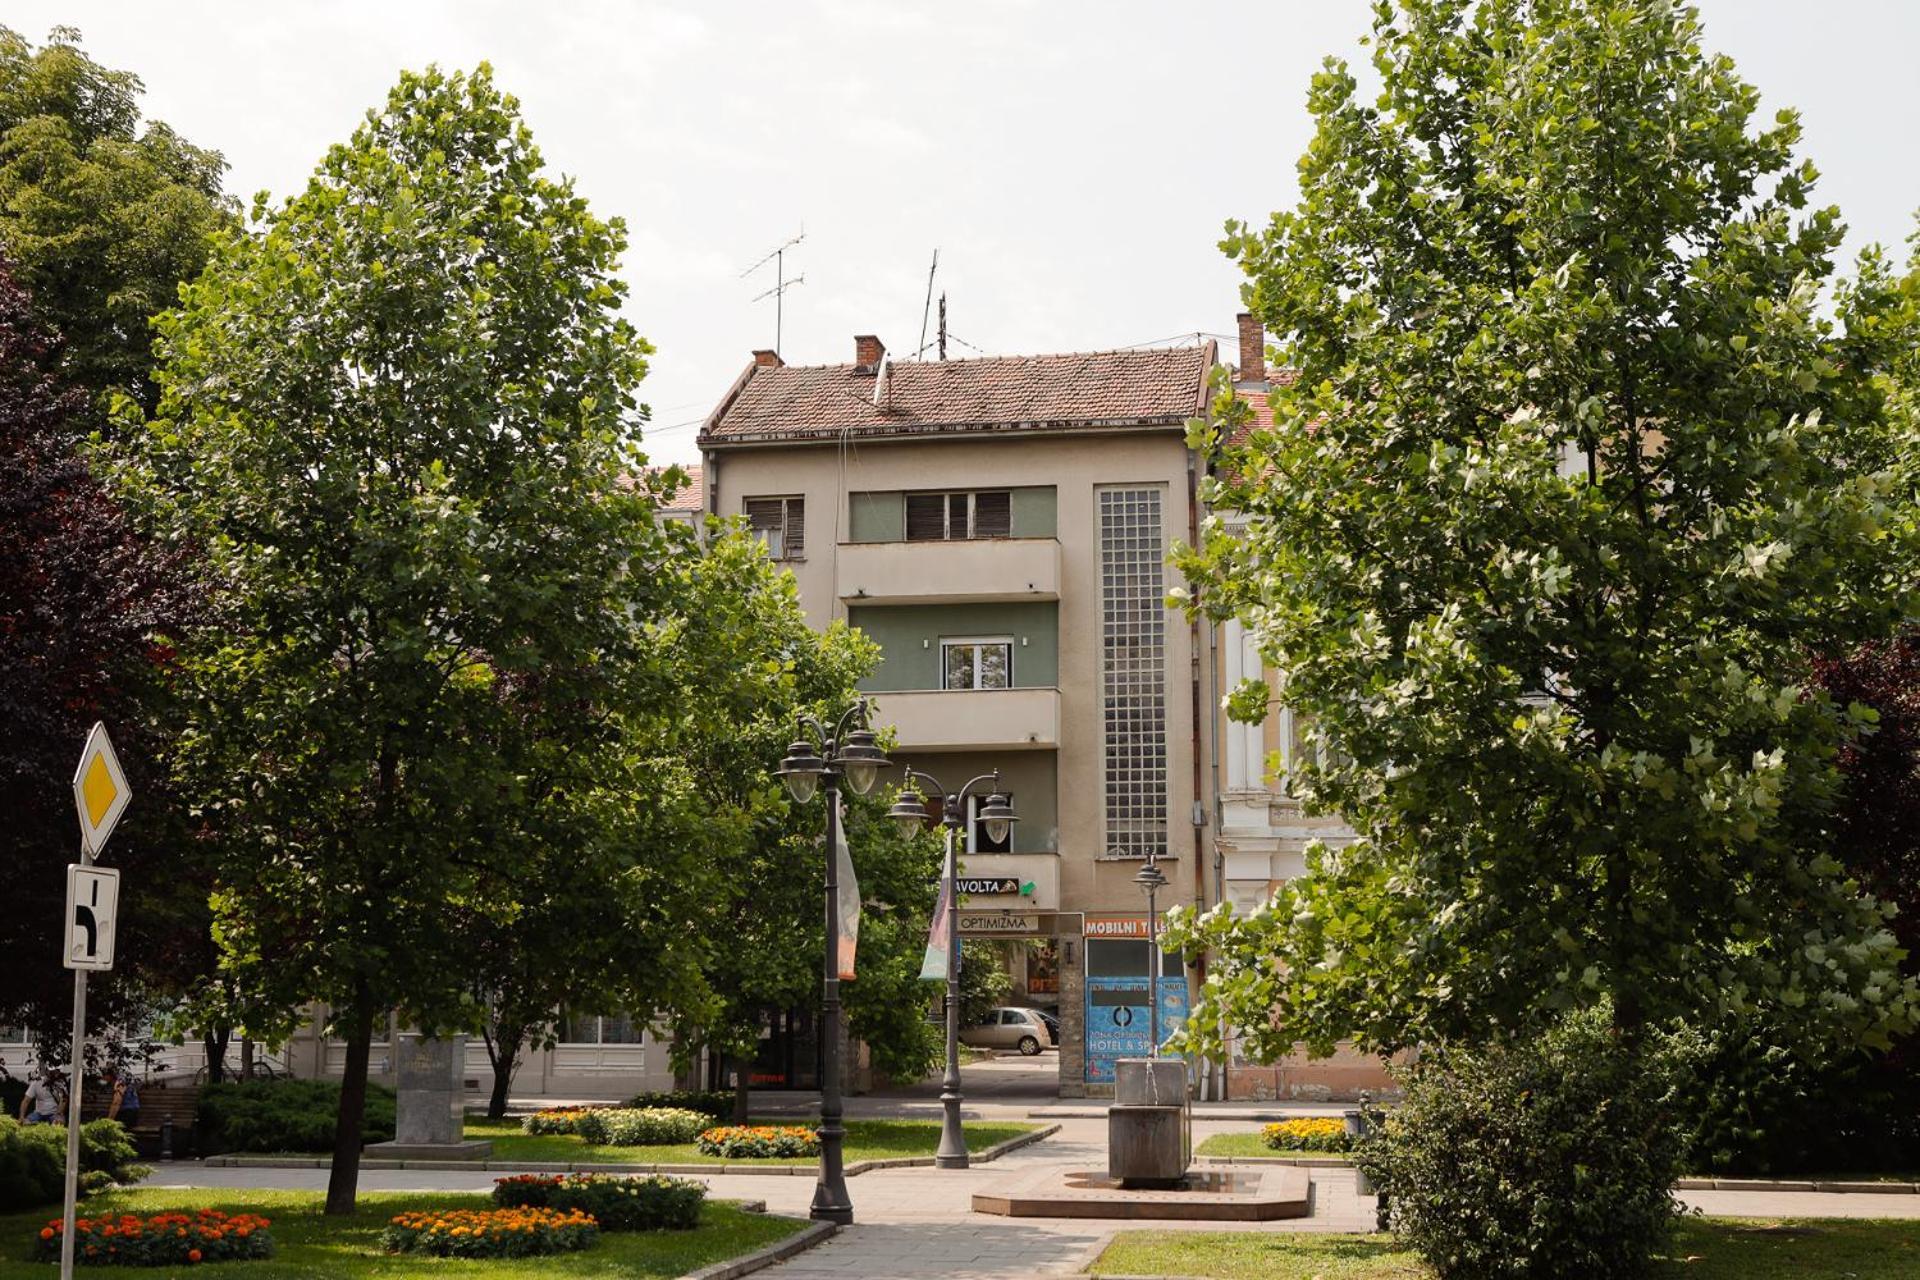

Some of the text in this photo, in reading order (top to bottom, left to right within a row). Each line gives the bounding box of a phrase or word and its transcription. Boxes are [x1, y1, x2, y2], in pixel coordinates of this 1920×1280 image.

[961, 918, 1026, 929] OPTIMIZMA
[1086, 922, 1137, 934] MOBILNI
[1089, 1040, 1122, 1051] HOTEL
